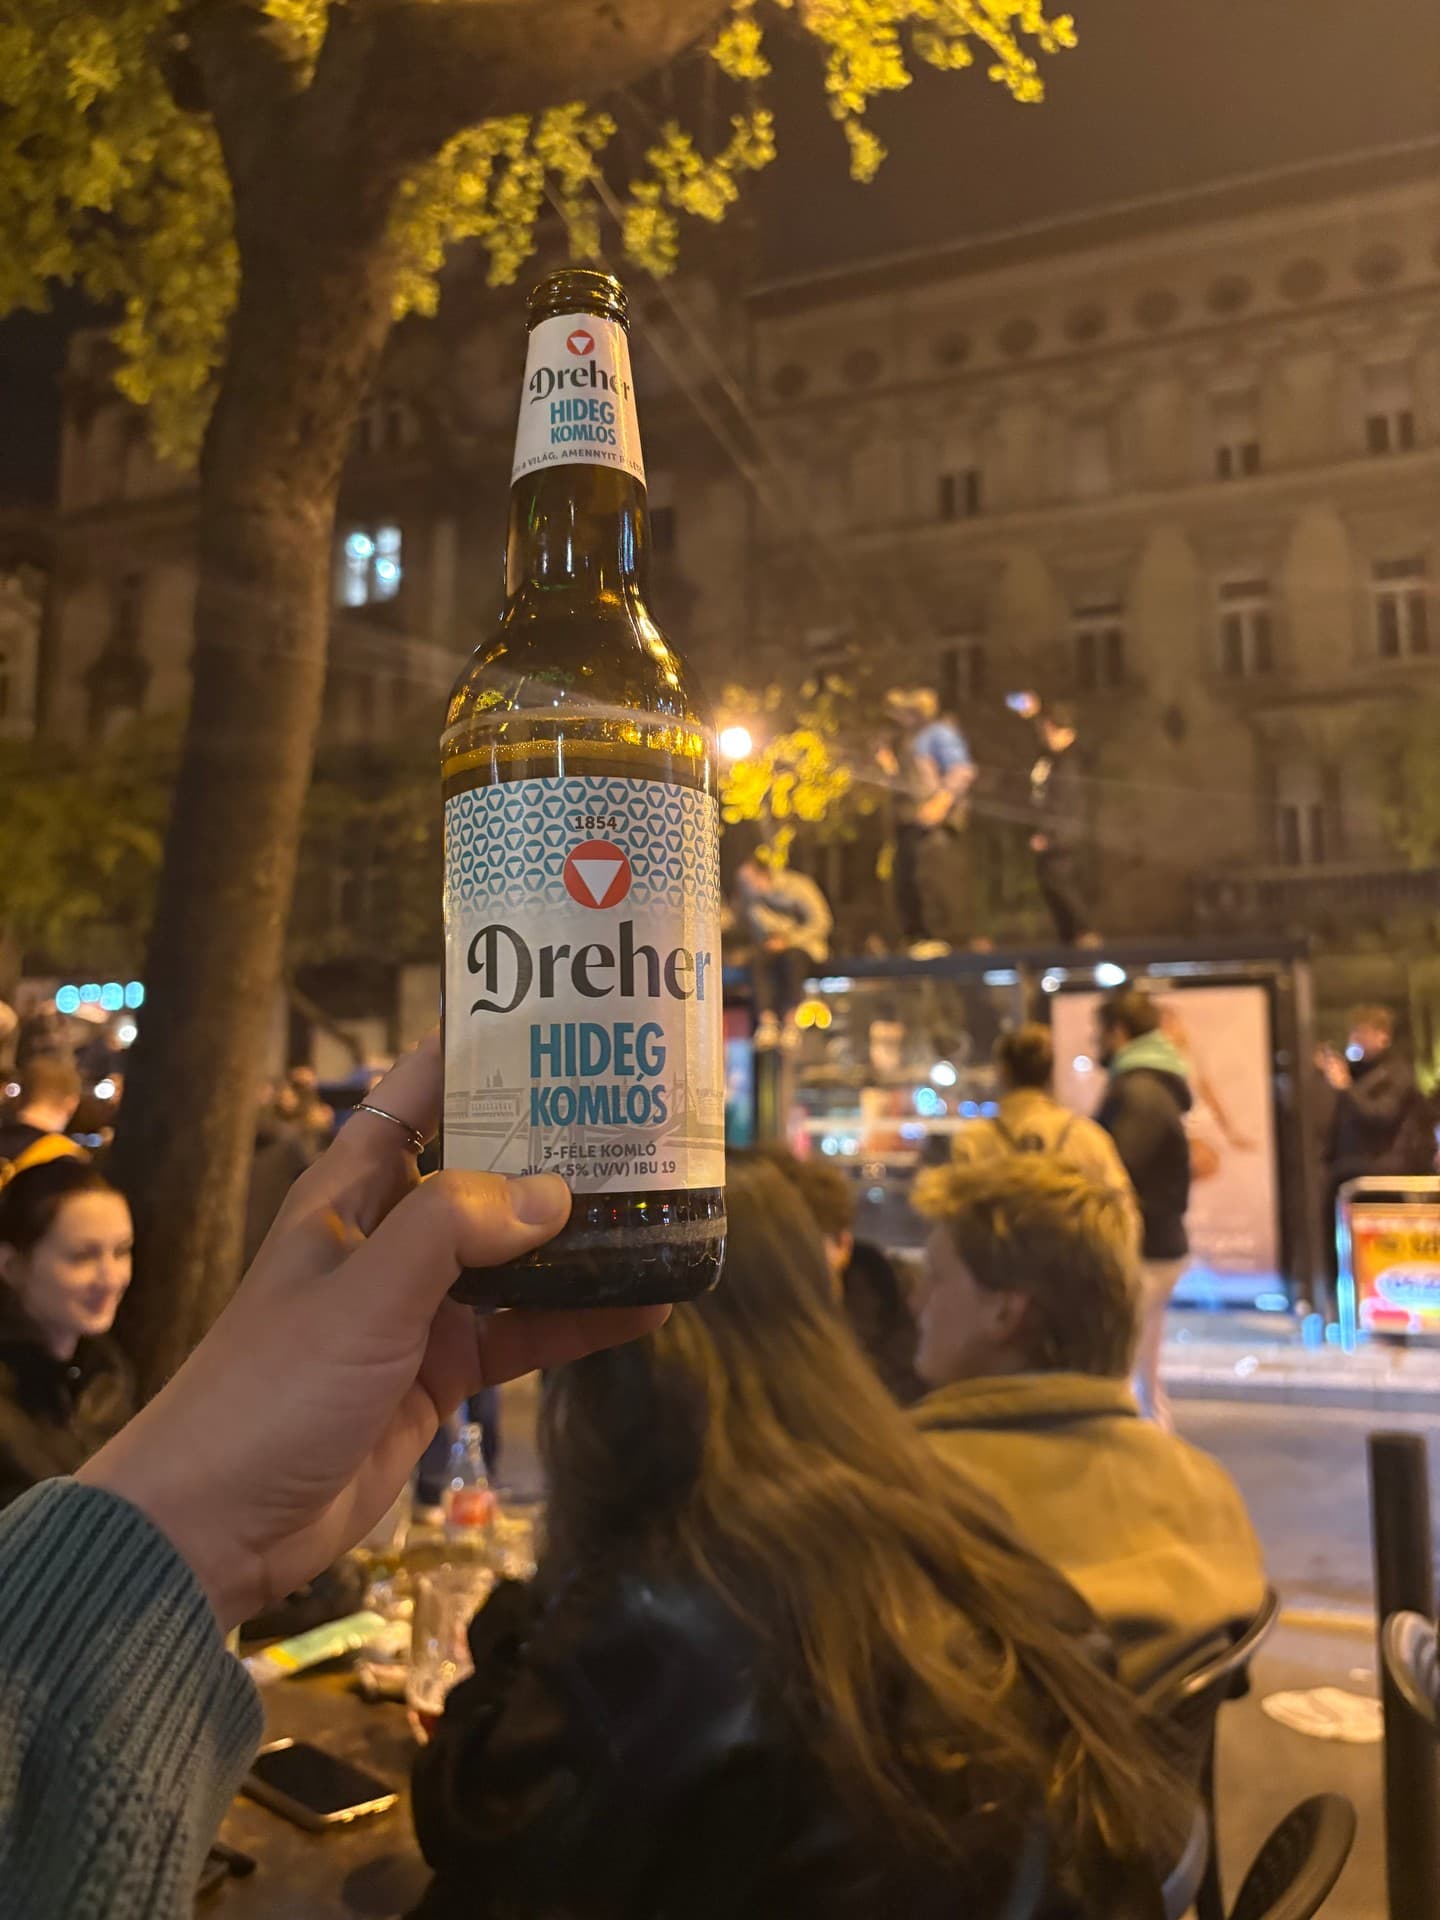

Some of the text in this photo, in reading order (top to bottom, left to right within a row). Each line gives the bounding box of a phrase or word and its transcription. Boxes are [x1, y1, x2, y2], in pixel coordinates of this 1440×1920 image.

[530, 360, 630, 404] Dreher
[550, 399, 615, 425] HIDEG
[561, 449, 616, 461] AMENNYIT
[574, 815, 618, 830] 1854
[467, 920, 711, 1016] Dreher
[530, 1022, 666, 1078] HIDEG
[530, 1073, 667, 1127] KOMLÓS
[543, 1142, 656, 1160] 3-FÉLE KOMLÓ
[593, 1161, 630, 1177] (V/V)
[634, 1161, 658, 1175] IBU
[660, 1160, 676, 1174] 19
